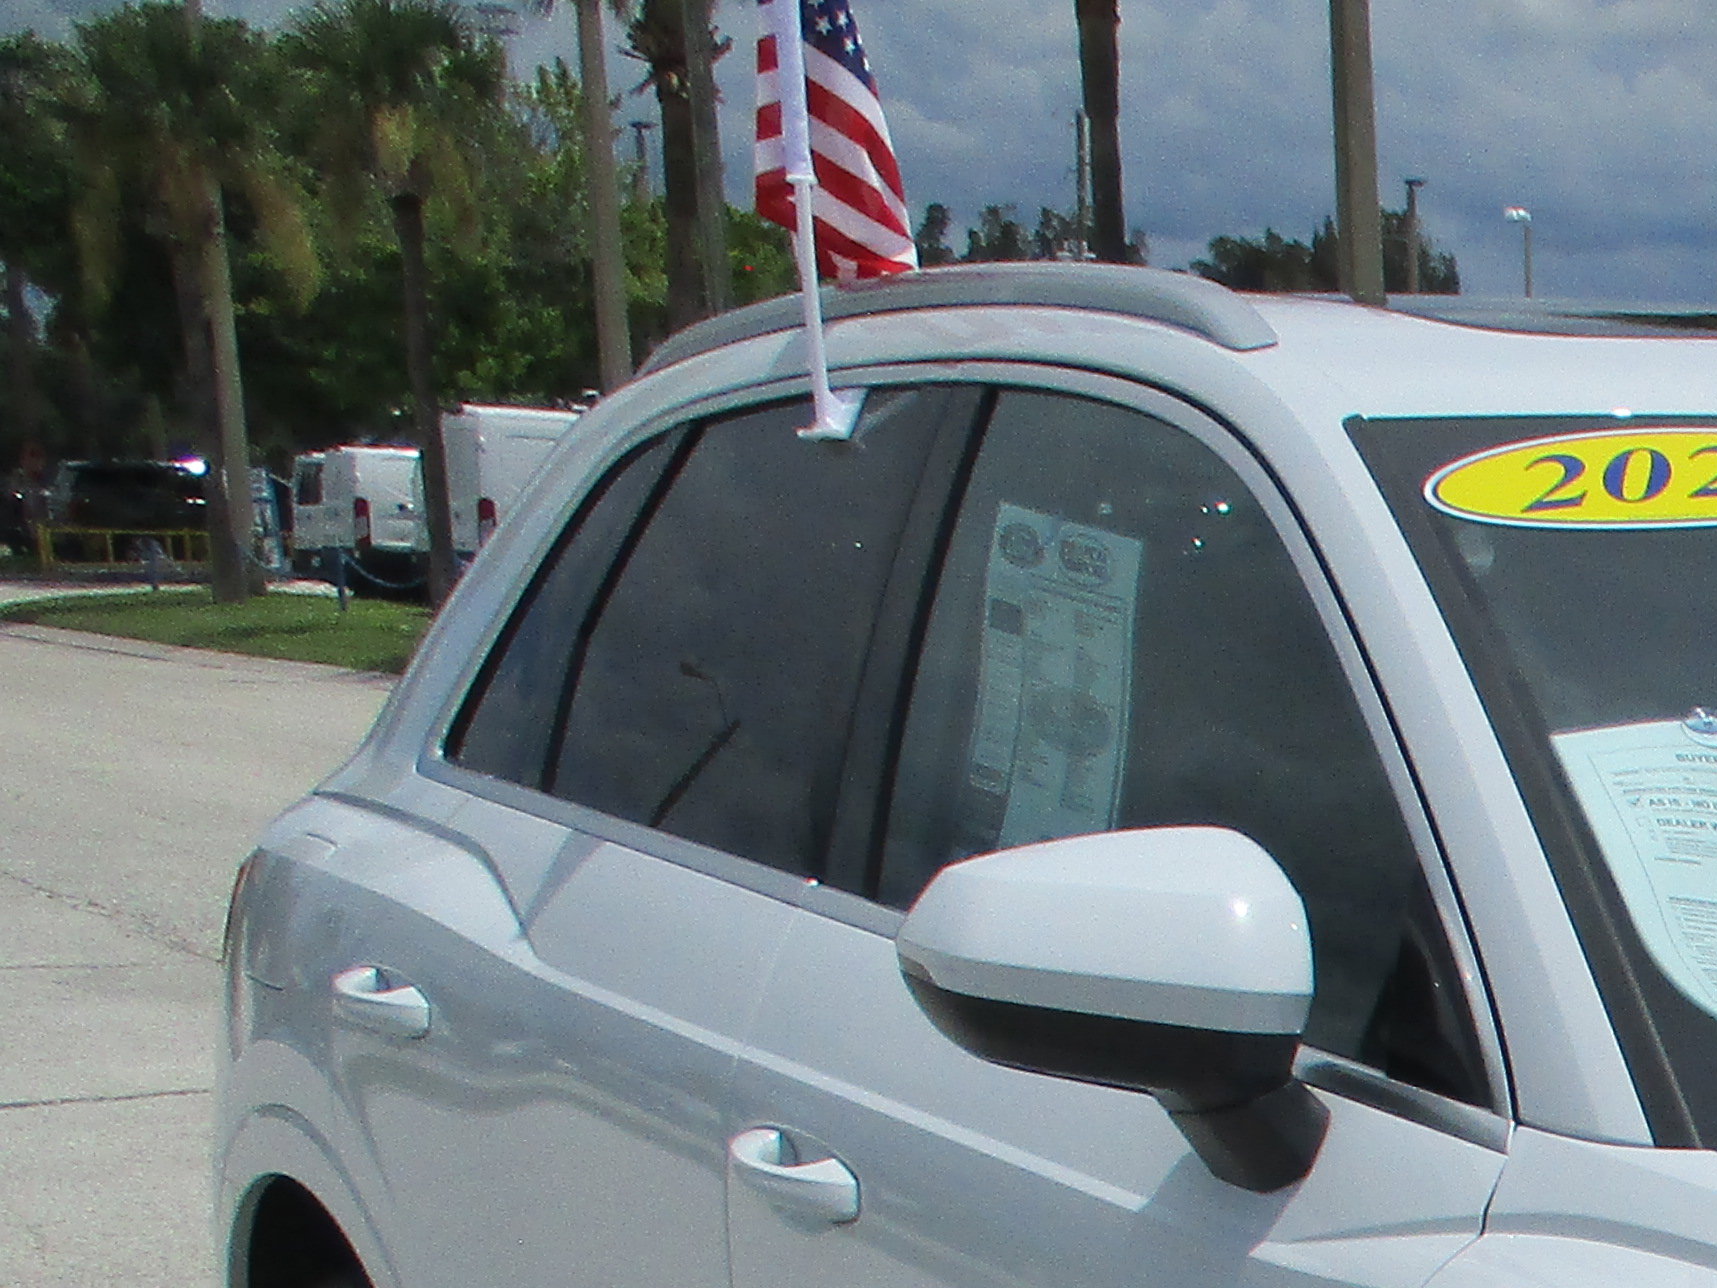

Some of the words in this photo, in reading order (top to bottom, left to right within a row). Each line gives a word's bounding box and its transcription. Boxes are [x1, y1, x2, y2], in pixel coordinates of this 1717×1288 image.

[1649, 798, 1666, 808] AS
[1691, 799, 1711, 810] NO
[1656, 817, 1707, 832] DEALER
